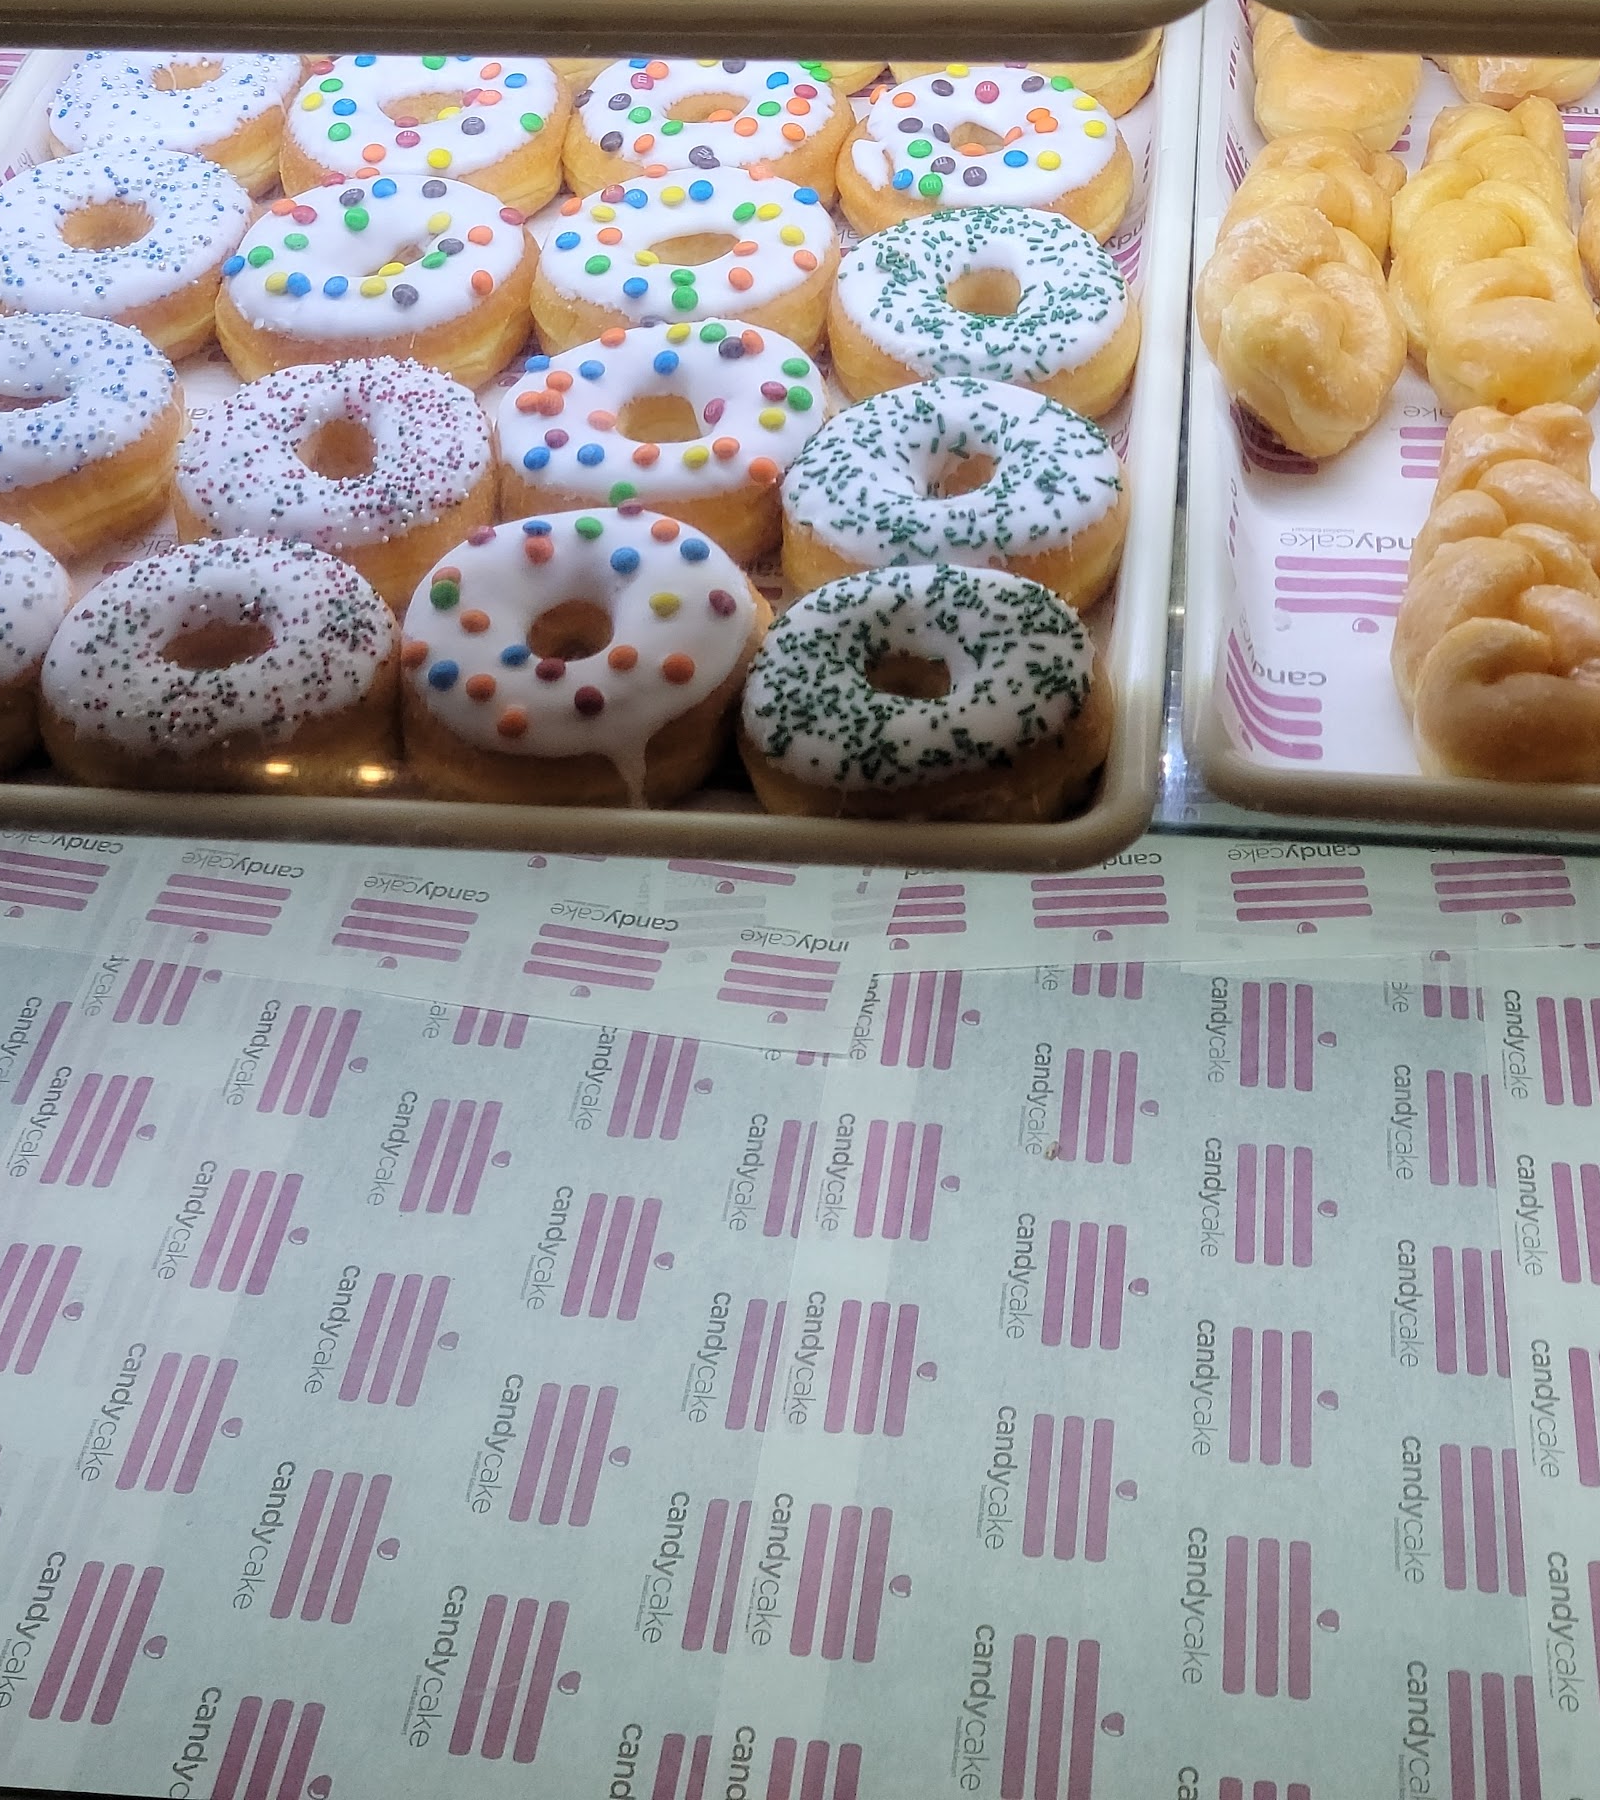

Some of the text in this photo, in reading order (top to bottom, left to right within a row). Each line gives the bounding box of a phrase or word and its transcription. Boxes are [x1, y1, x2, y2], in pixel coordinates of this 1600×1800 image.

[181, 850, 304, 878] candycake
[364, 875, 490, 903] candycake
[550, 901, 680, 931] candycake
[226, 999, 281, 1106] candycake
[575, 1026, 618, 1131] andycake
[1207, 976, 1229, 1083] candycake
[1503, 989, 1529, 1100] candycake
[9, 1065, 73, 1179] candycake
[367, 1090, 418, 1207] candycake
[1025, 1042, 1053, 1155] candycake
[1391, 1064, 1414, 1181] candycake
[158, 1160, 217, 1280] candycake
[730, 1113, 769, 1232] candycake
[821, 1113, 856, 1232] candycake
[1199, 1137, 1223, 1257] candycake
[1516, 1154, 1543, 1276] candycake
[527, 1185, 574, 1311] candycake
[1005, 1213, 1035, 1340] candycake
[1396, 1239, 1419, 1367] candycake
[304, 1264, 360, 1395] candycake
[688, 1291, 732, 1424] candycake
[788, 1290, 826, 1426] candycake
[1192, 1319, 1216, 1456] candycake
[81, 1343, 147, 1481] candycake
[471, 1373, 524, 1515] candycake
[1530, 1339, 1560, 1479] candycake
[232, 1460, 296, 1611] candycake
[985, 1406, 1017, 1550] candycake
[1398, 1436, 1426, 1585] candycake
[641, 1491, 690, 1645] candycake
[751, 1492, 794, 1647] candycake
[1180, 1527, 1208, 1685] candycake
[409, 1584, 468, 1749] candycake
[1546, 1551, 1583, 1713] candycake
[960, 1624, 996, 1792] candycake
[1402, 1660, 1433, 1800] candyca
